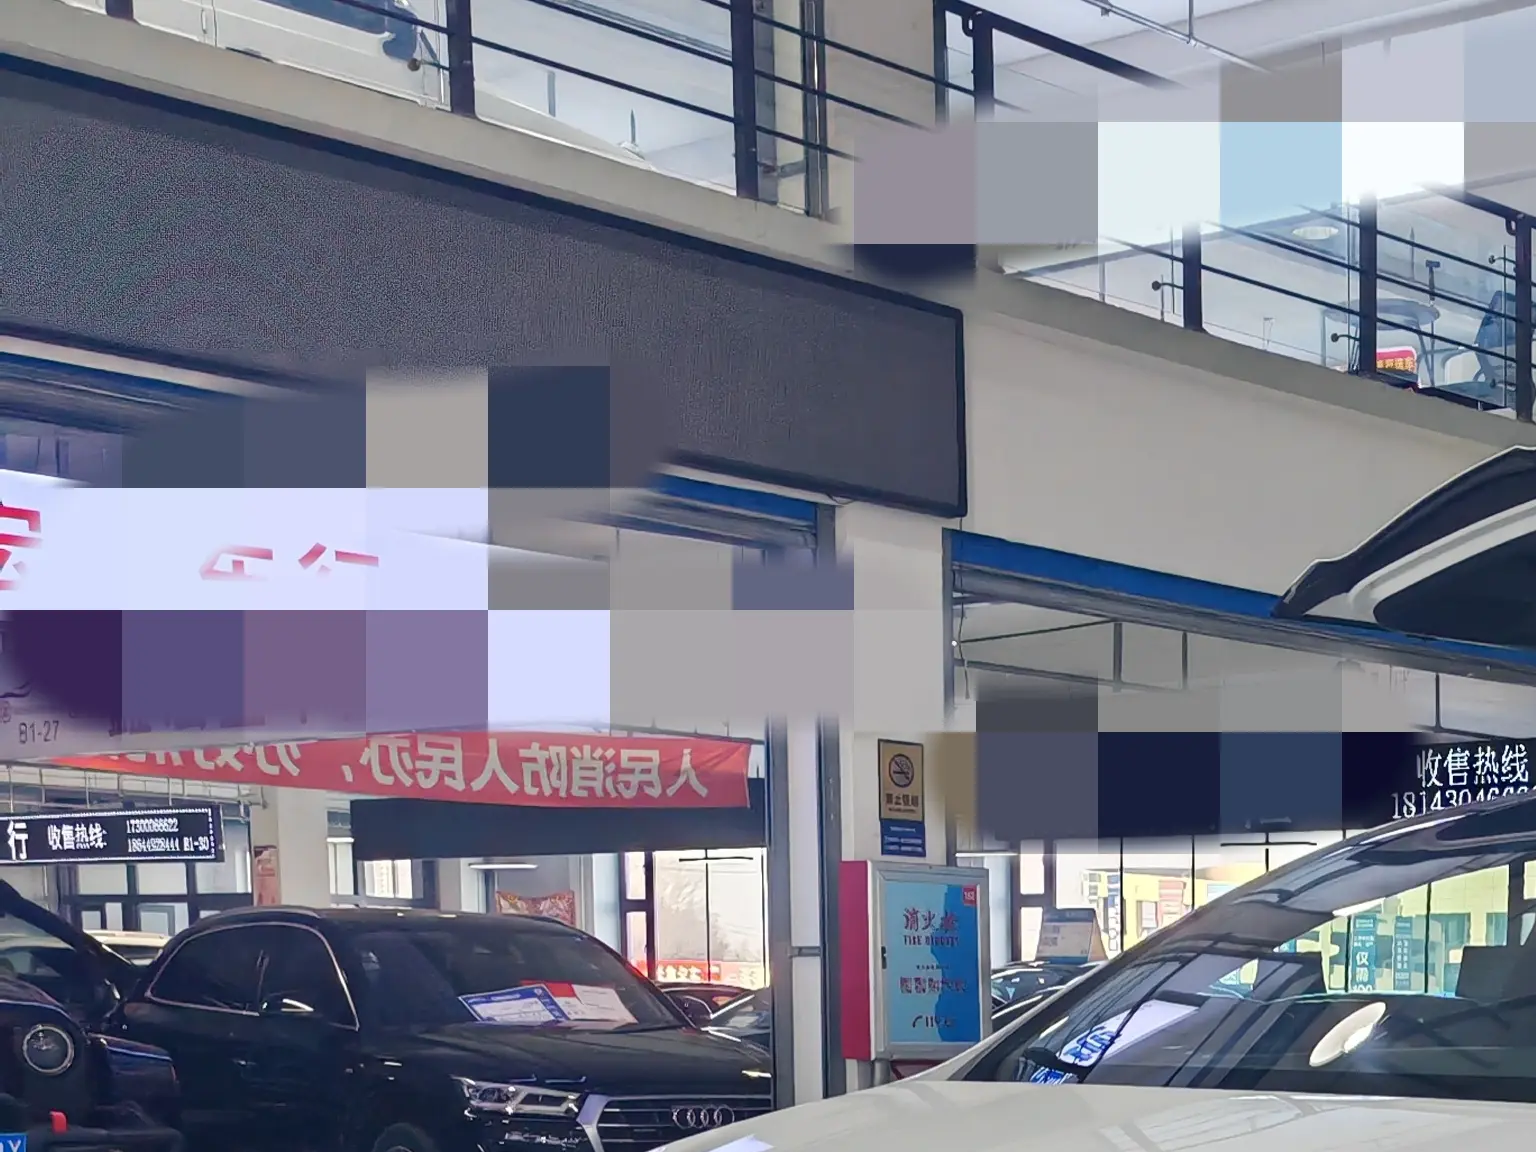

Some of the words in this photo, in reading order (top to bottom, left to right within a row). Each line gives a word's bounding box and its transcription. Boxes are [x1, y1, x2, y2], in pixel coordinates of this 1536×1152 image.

[1416, 743, 1529, 788] 收售热线
[7, 820, 28, 861] 行
